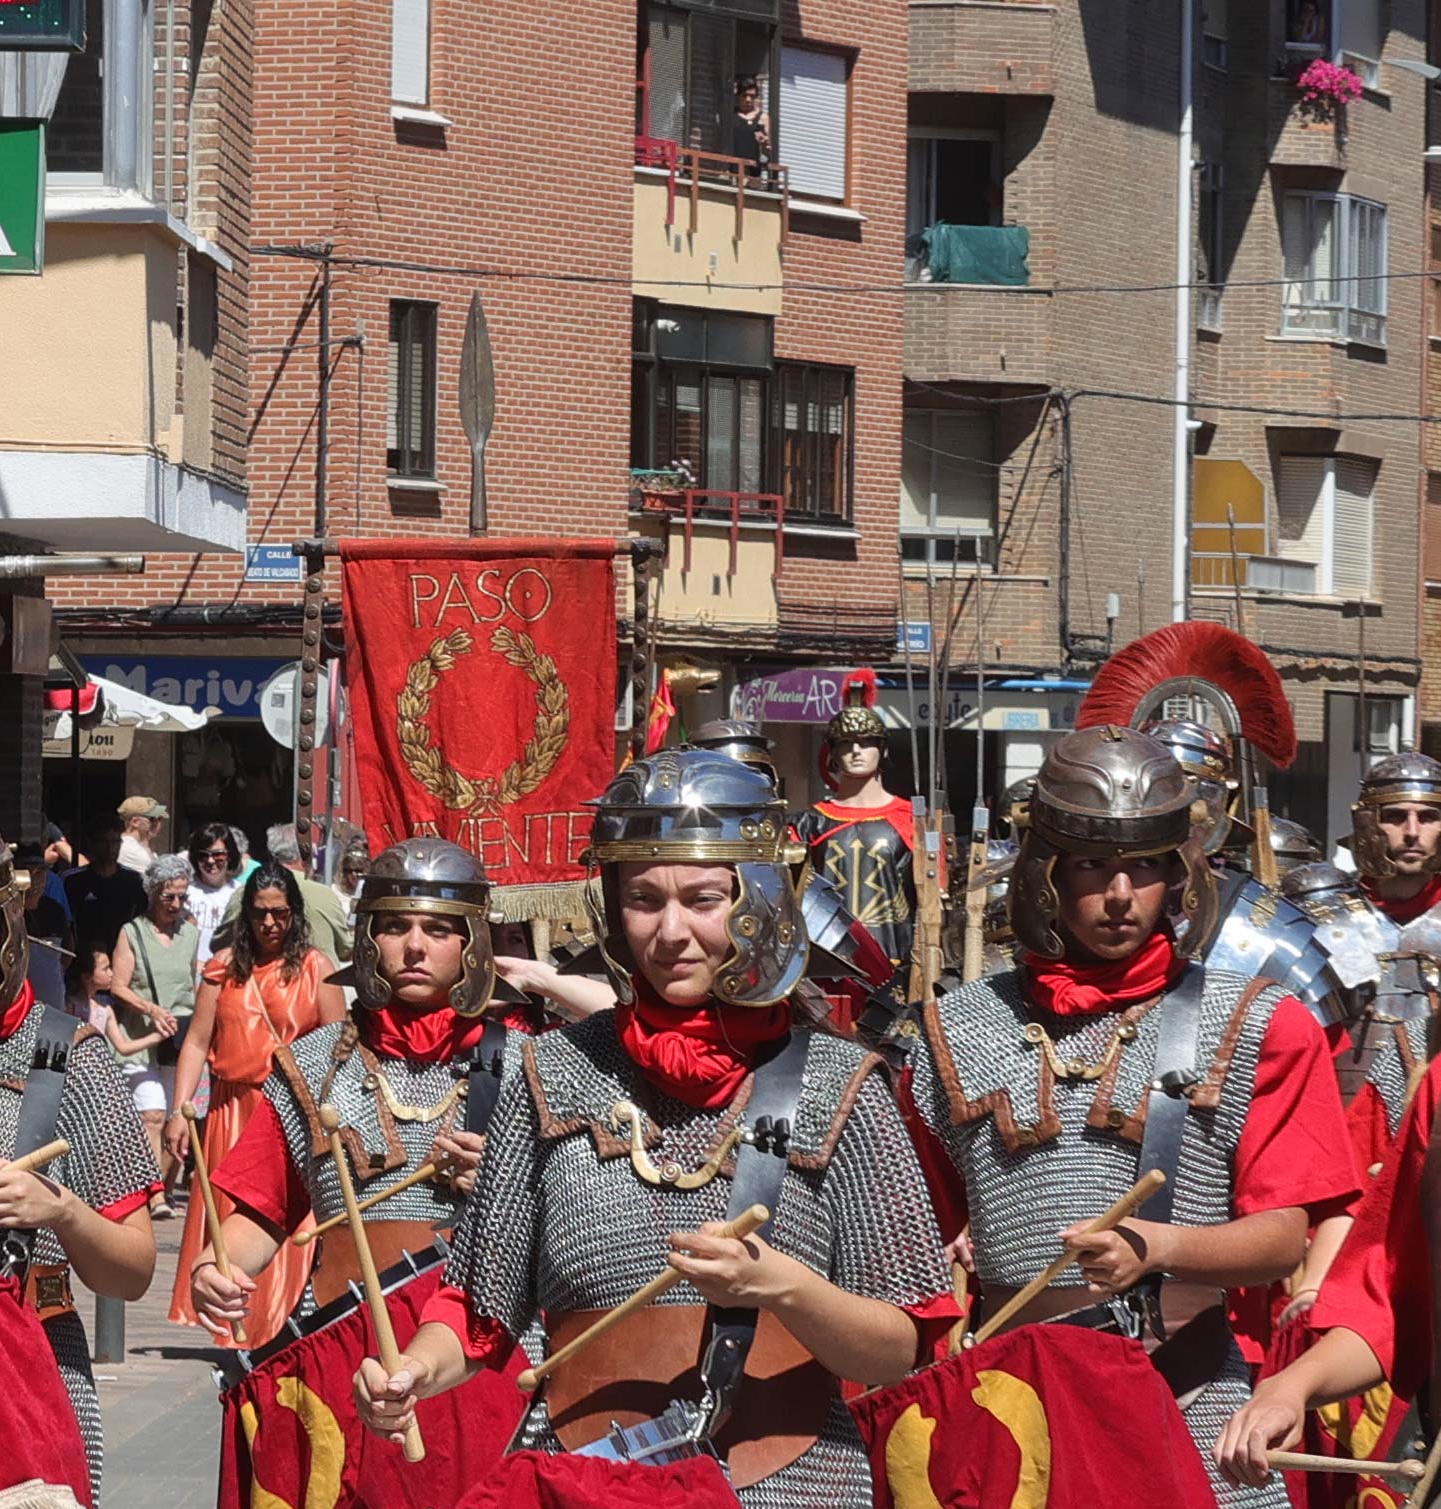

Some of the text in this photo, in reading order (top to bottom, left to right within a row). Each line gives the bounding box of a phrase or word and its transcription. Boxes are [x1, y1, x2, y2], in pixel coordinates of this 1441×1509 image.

[266, 551, 292, 559] CALLE
[409, 568, 552, 628] PASO
[105, 665, 271, 706] Mariv
